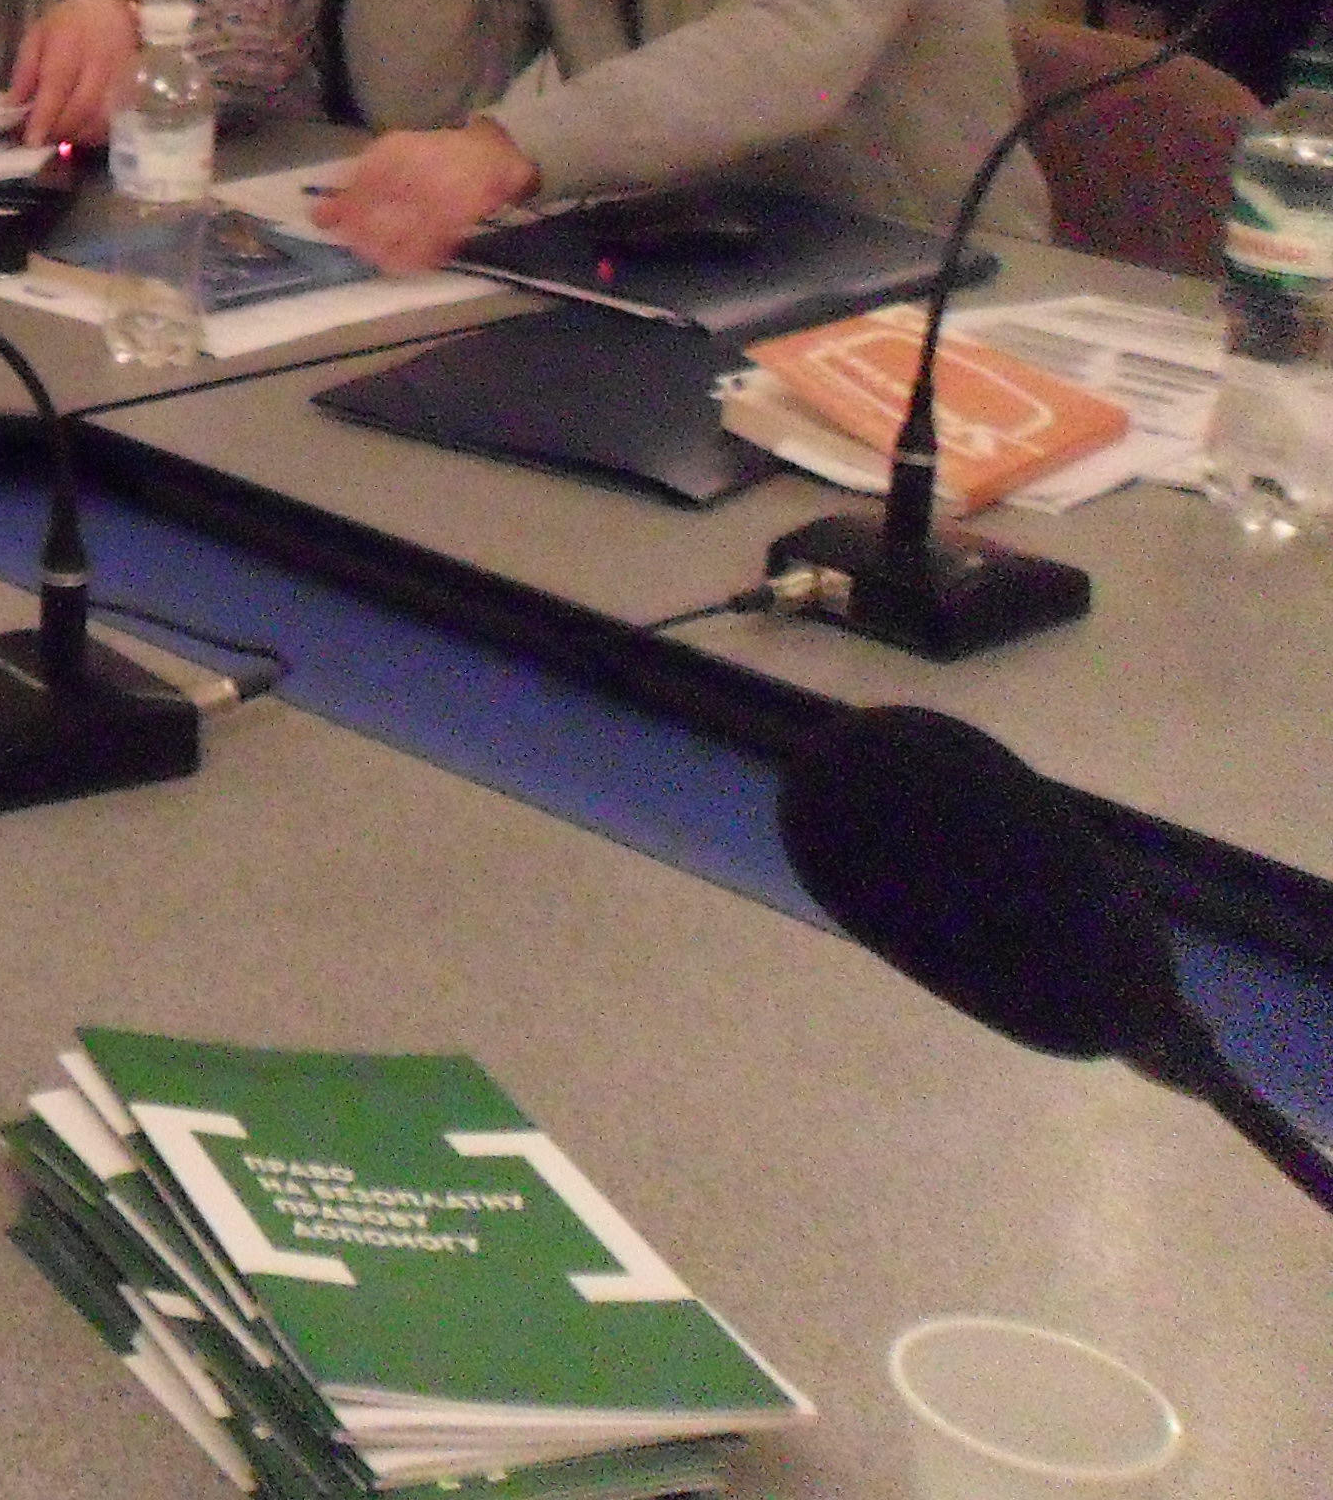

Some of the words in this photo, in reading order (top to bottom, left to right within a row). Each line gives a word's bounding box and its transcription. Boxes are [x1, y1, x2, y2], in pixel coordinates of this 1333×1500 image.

[240, 1151, 357, 1184] ПРАВО
[255, 1174, 308, 1198] НА
[309, 1180, 525, 1212] БЕЗОПЛАТНУ
[272, 1196, 429, 1229] ПРАВОВУ
[292, 1218, 480, 1254] ДОПОМОГУ
